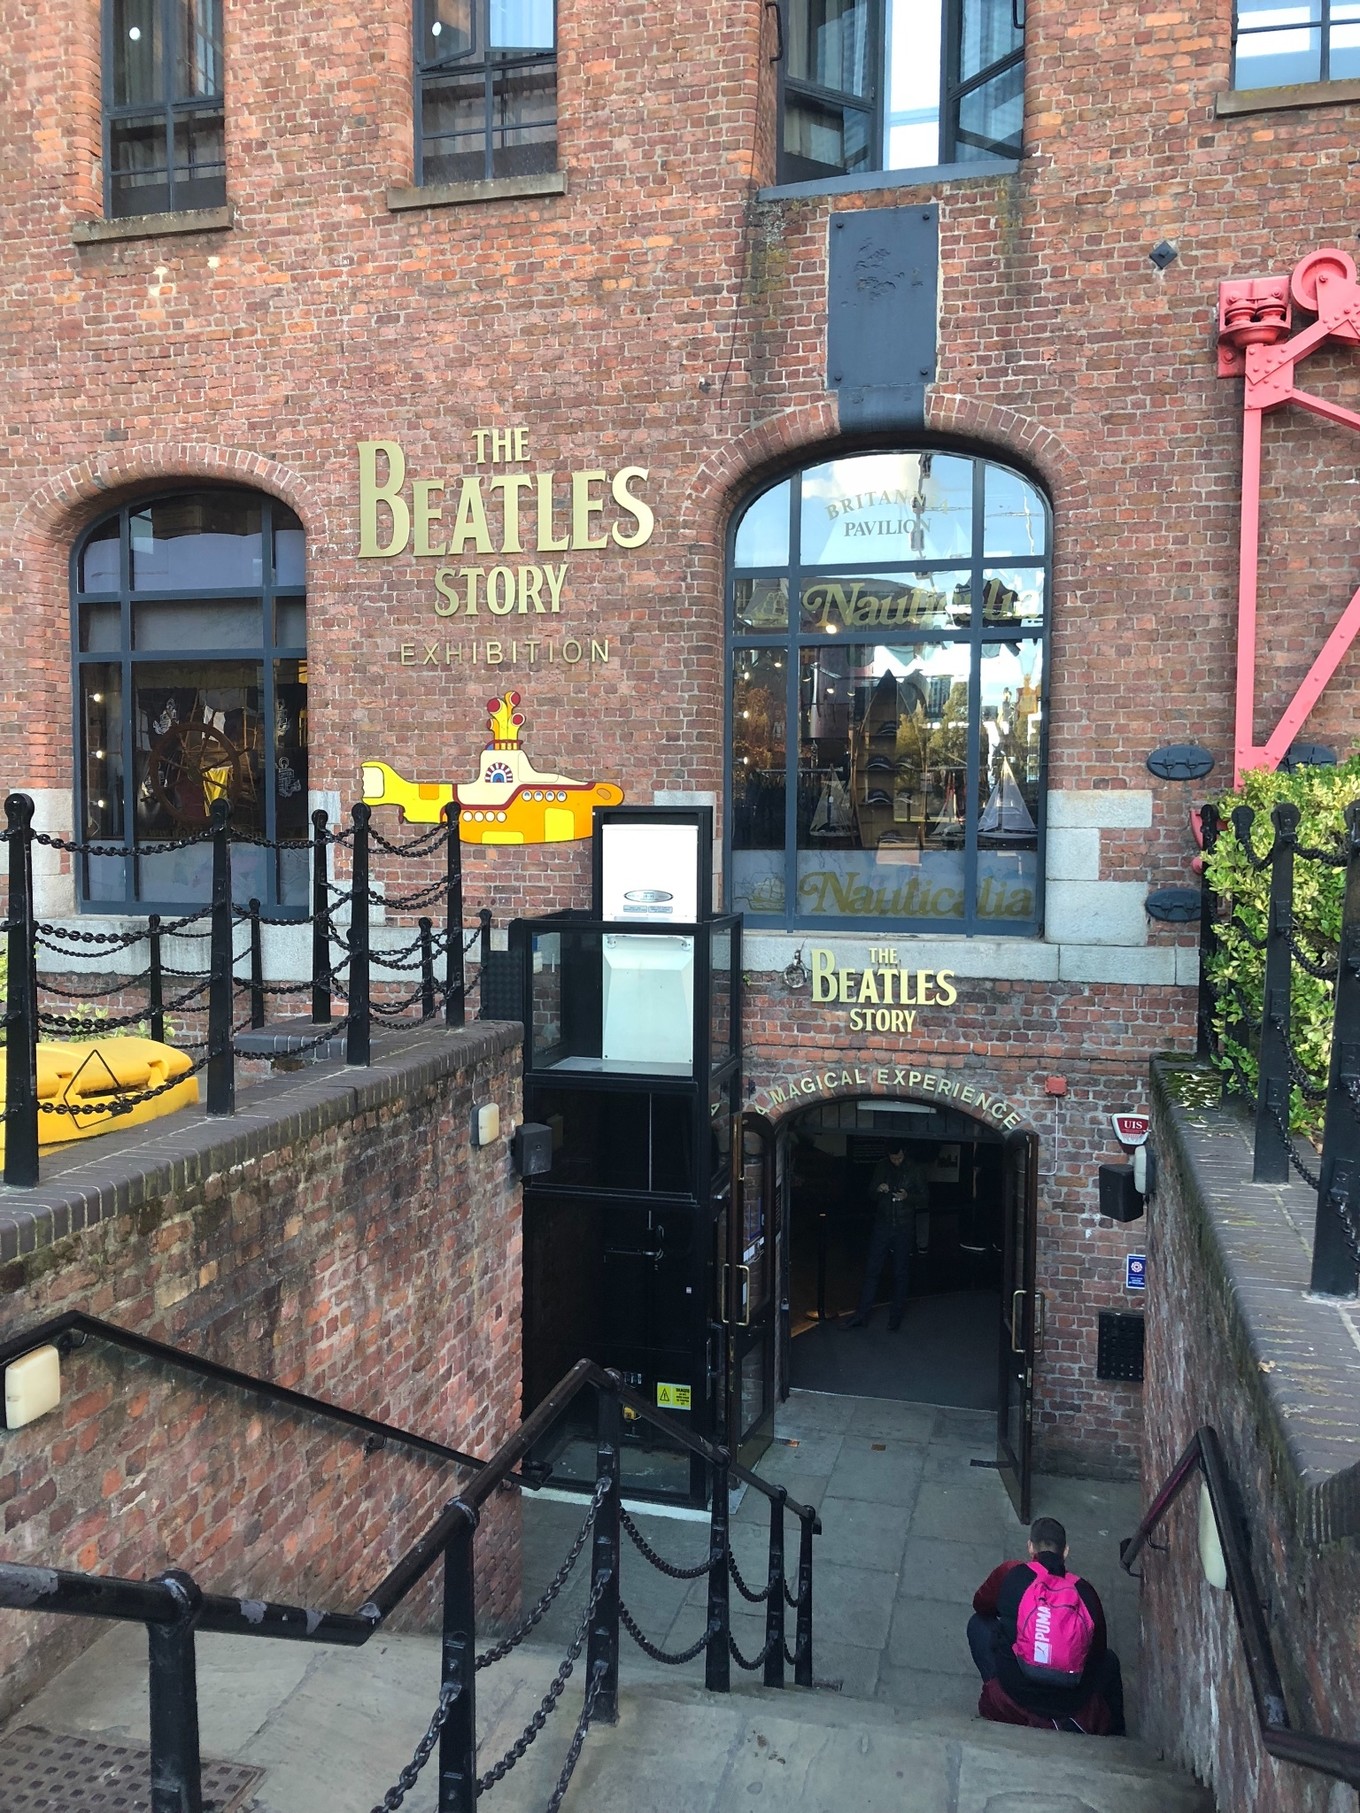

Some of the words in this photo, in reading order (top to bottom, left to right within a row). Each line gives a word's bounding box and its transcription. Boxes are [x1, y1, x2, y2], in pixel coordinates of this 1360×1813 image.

[471, 427, 531, 464] THE
[357, 440, 655, 559] BEATLES
[824, 488, 949, 520] BRITANNA
[843, 517, 932, 537] PAVILION
[434, 563, 569, 617] STORY
[400, 639, 610, 666] EXHIBITION
[869, 947, 898, 964] THE
[811, 948, 958, 1007] BEATLES
[849, 1008, 917, 1033] STORY
[755, 1105, 770, 1115] A
[769, 1068, 867, 1105] MAGICAL
[877, 1068, 1022, 1130] EXPERIENCE
[1123, 1120, 1143, 1129] UIS
[1034, 1605, 1051, 1642] PUMA
